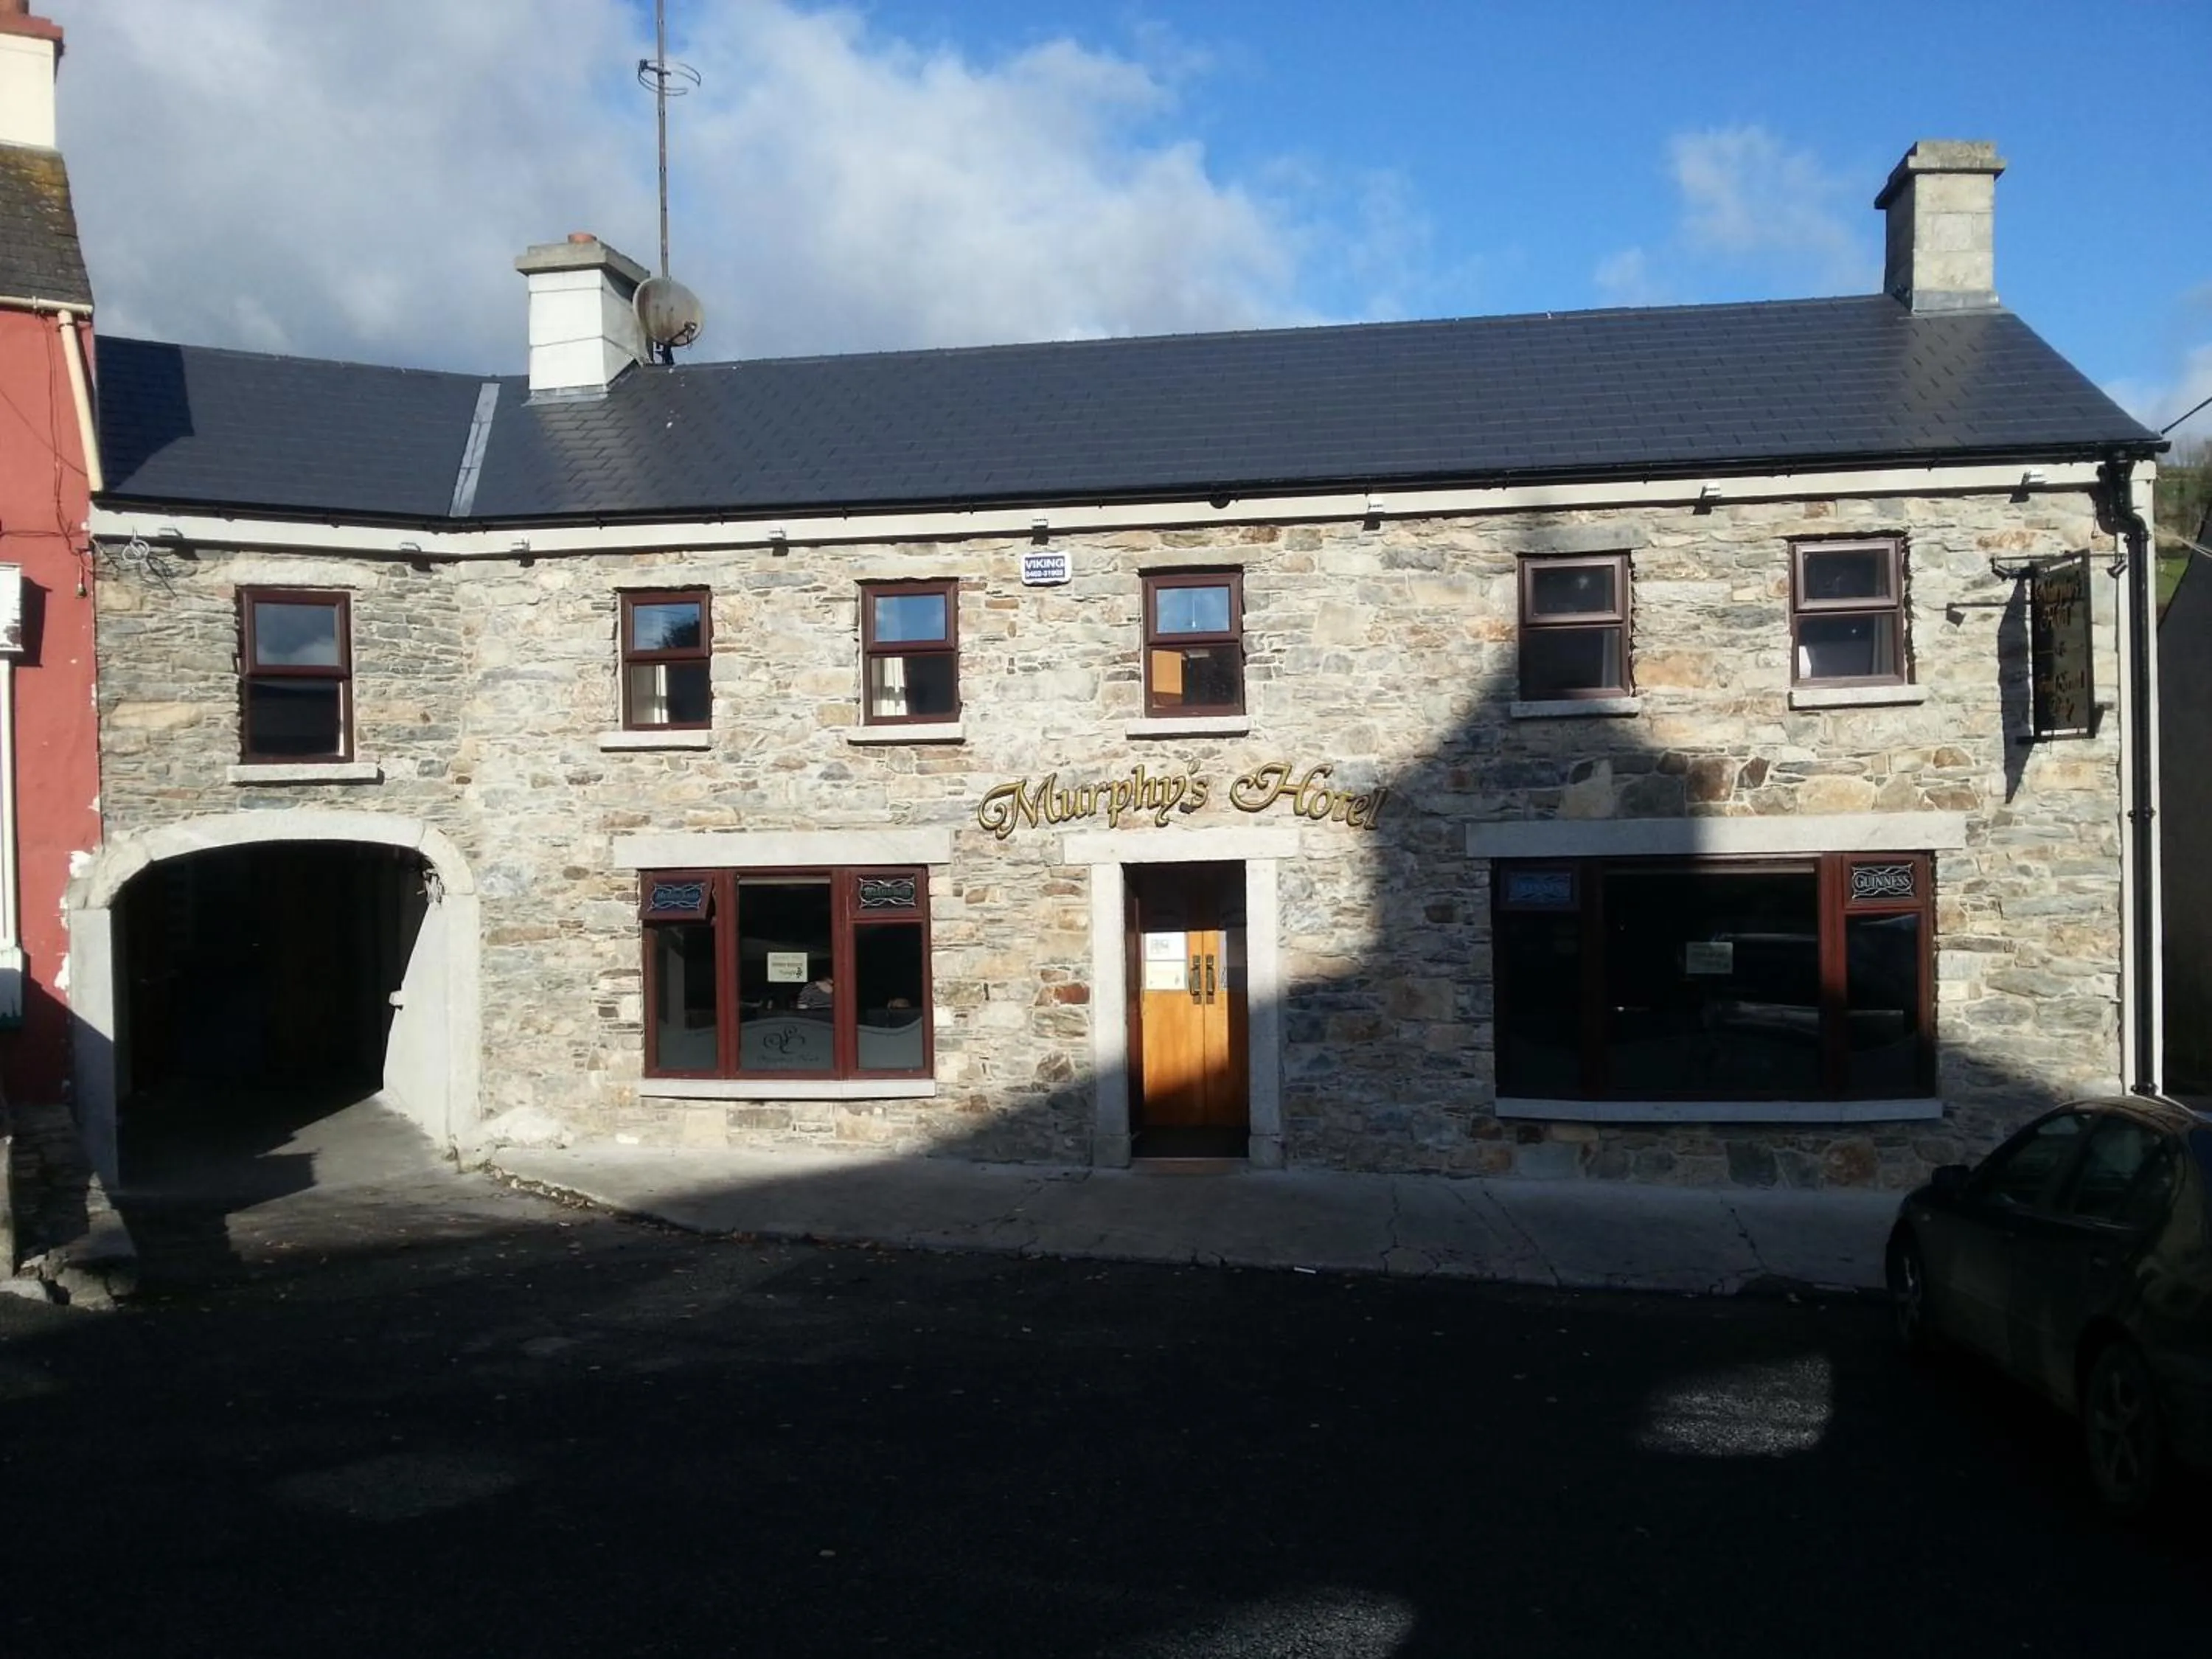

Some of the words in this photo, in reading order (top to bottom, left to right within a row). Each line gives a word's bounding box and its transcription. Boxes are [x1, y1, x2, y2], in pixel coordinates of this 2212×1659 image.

[1025, 558, 1064, 568] VIKING
[978, 758, 1209, 839] Murphy's
[1229, 761, 1388, 830] Hotel
[1855, 874, 1910, 888] GUINNESS
